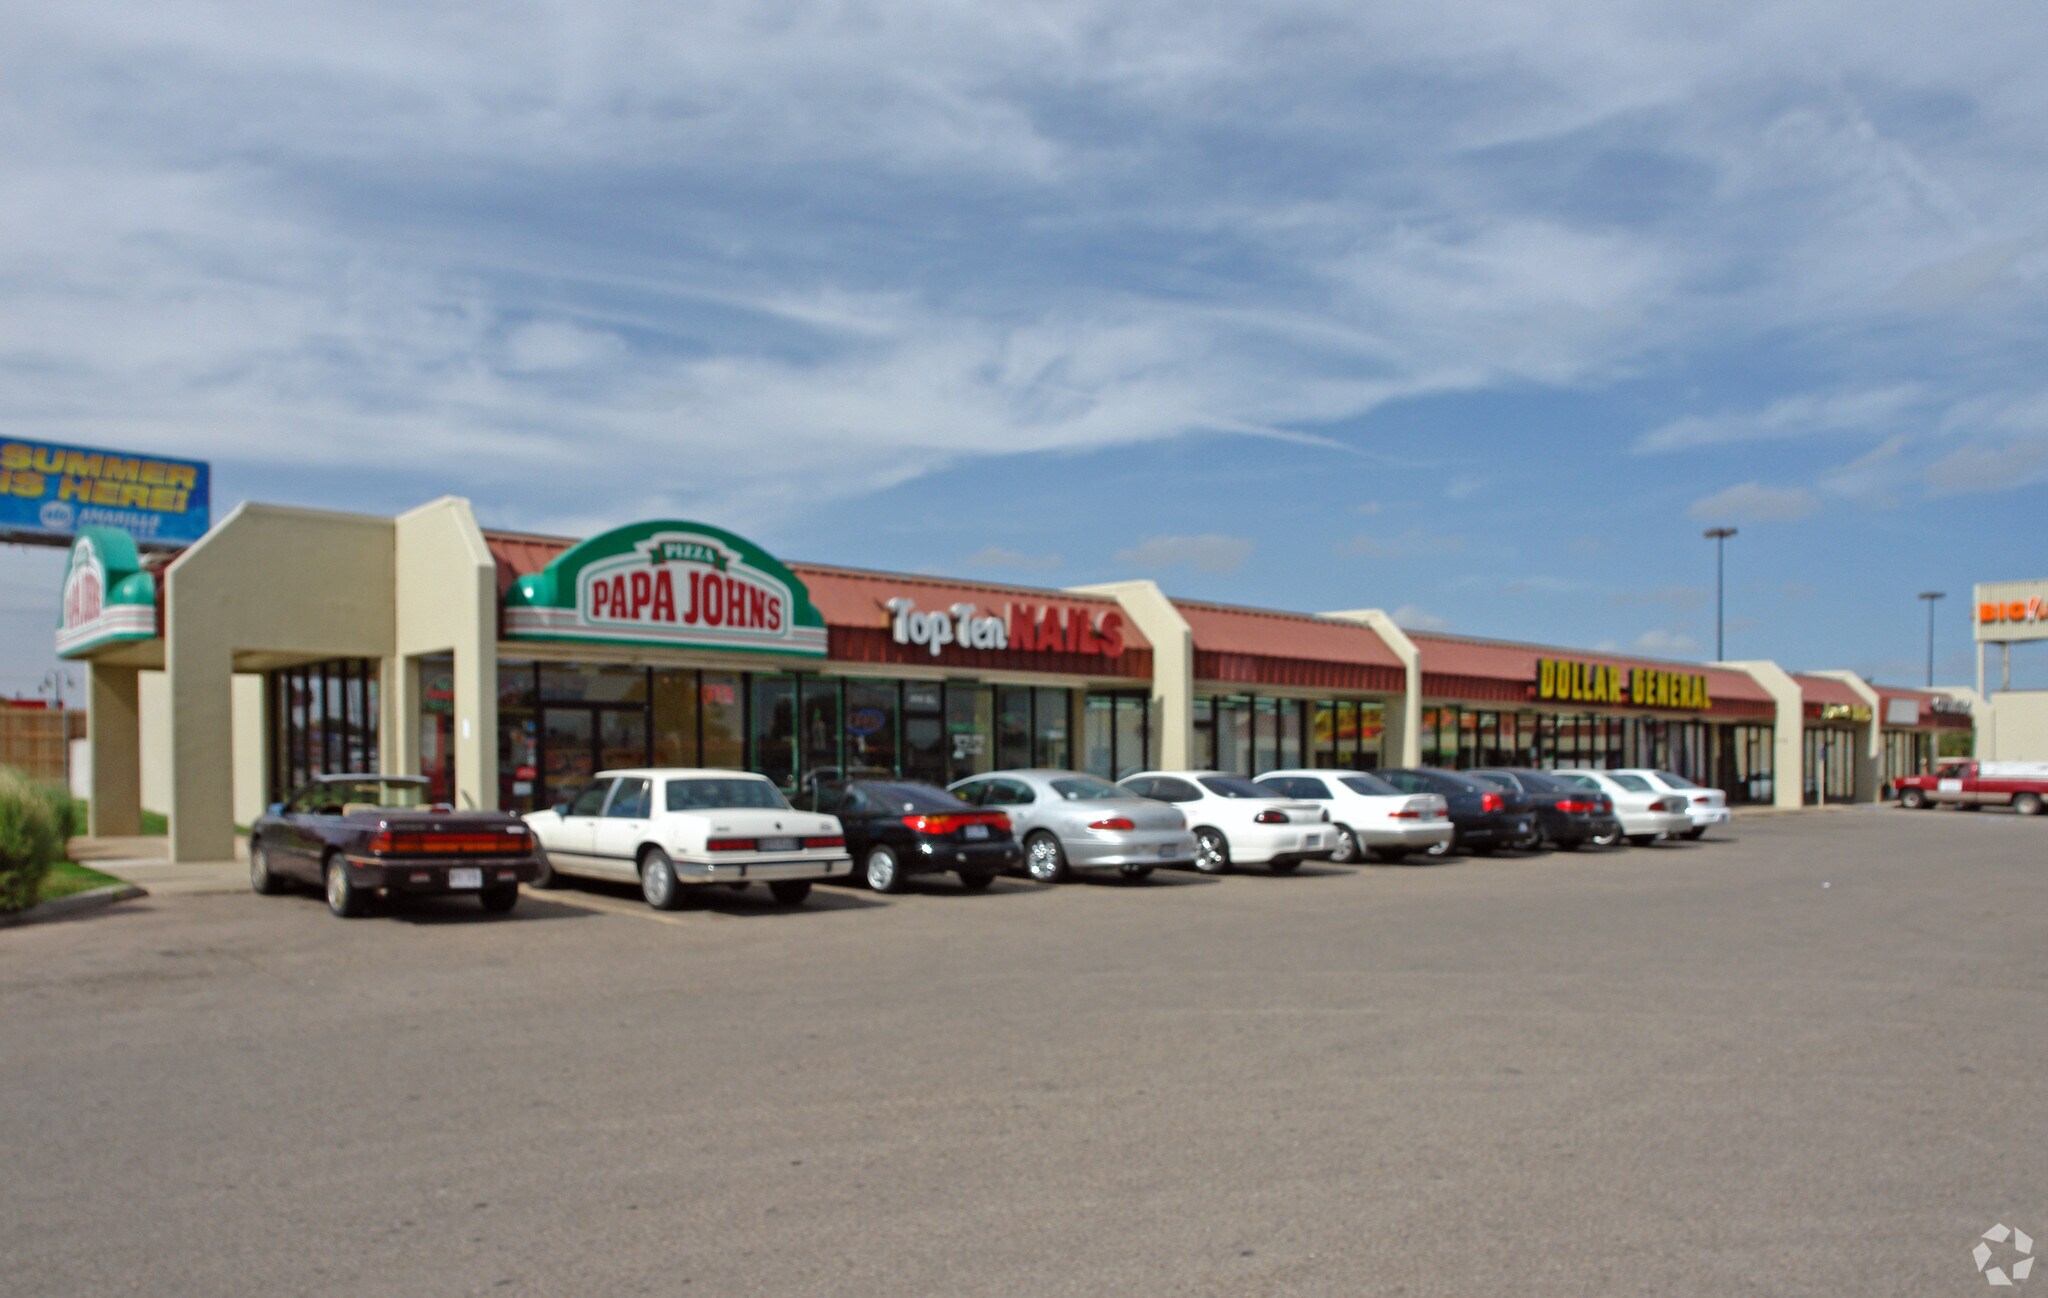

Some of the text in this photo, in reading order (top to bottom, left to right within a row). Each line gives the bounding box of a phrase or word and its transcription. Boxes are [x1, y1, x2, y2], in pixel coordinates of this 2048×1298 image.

[0, 443, 196, 489] SUMMER
[0, 470, 45, 498] IS
[663, 542, 715, 563] PIZZA
[592, 570, 782, 631] PAPA JOHNS
[888, 597, 1124, 657] Top Ten NAILS
[1537, 658, 1712, 709] DOLLAR GENERAL
